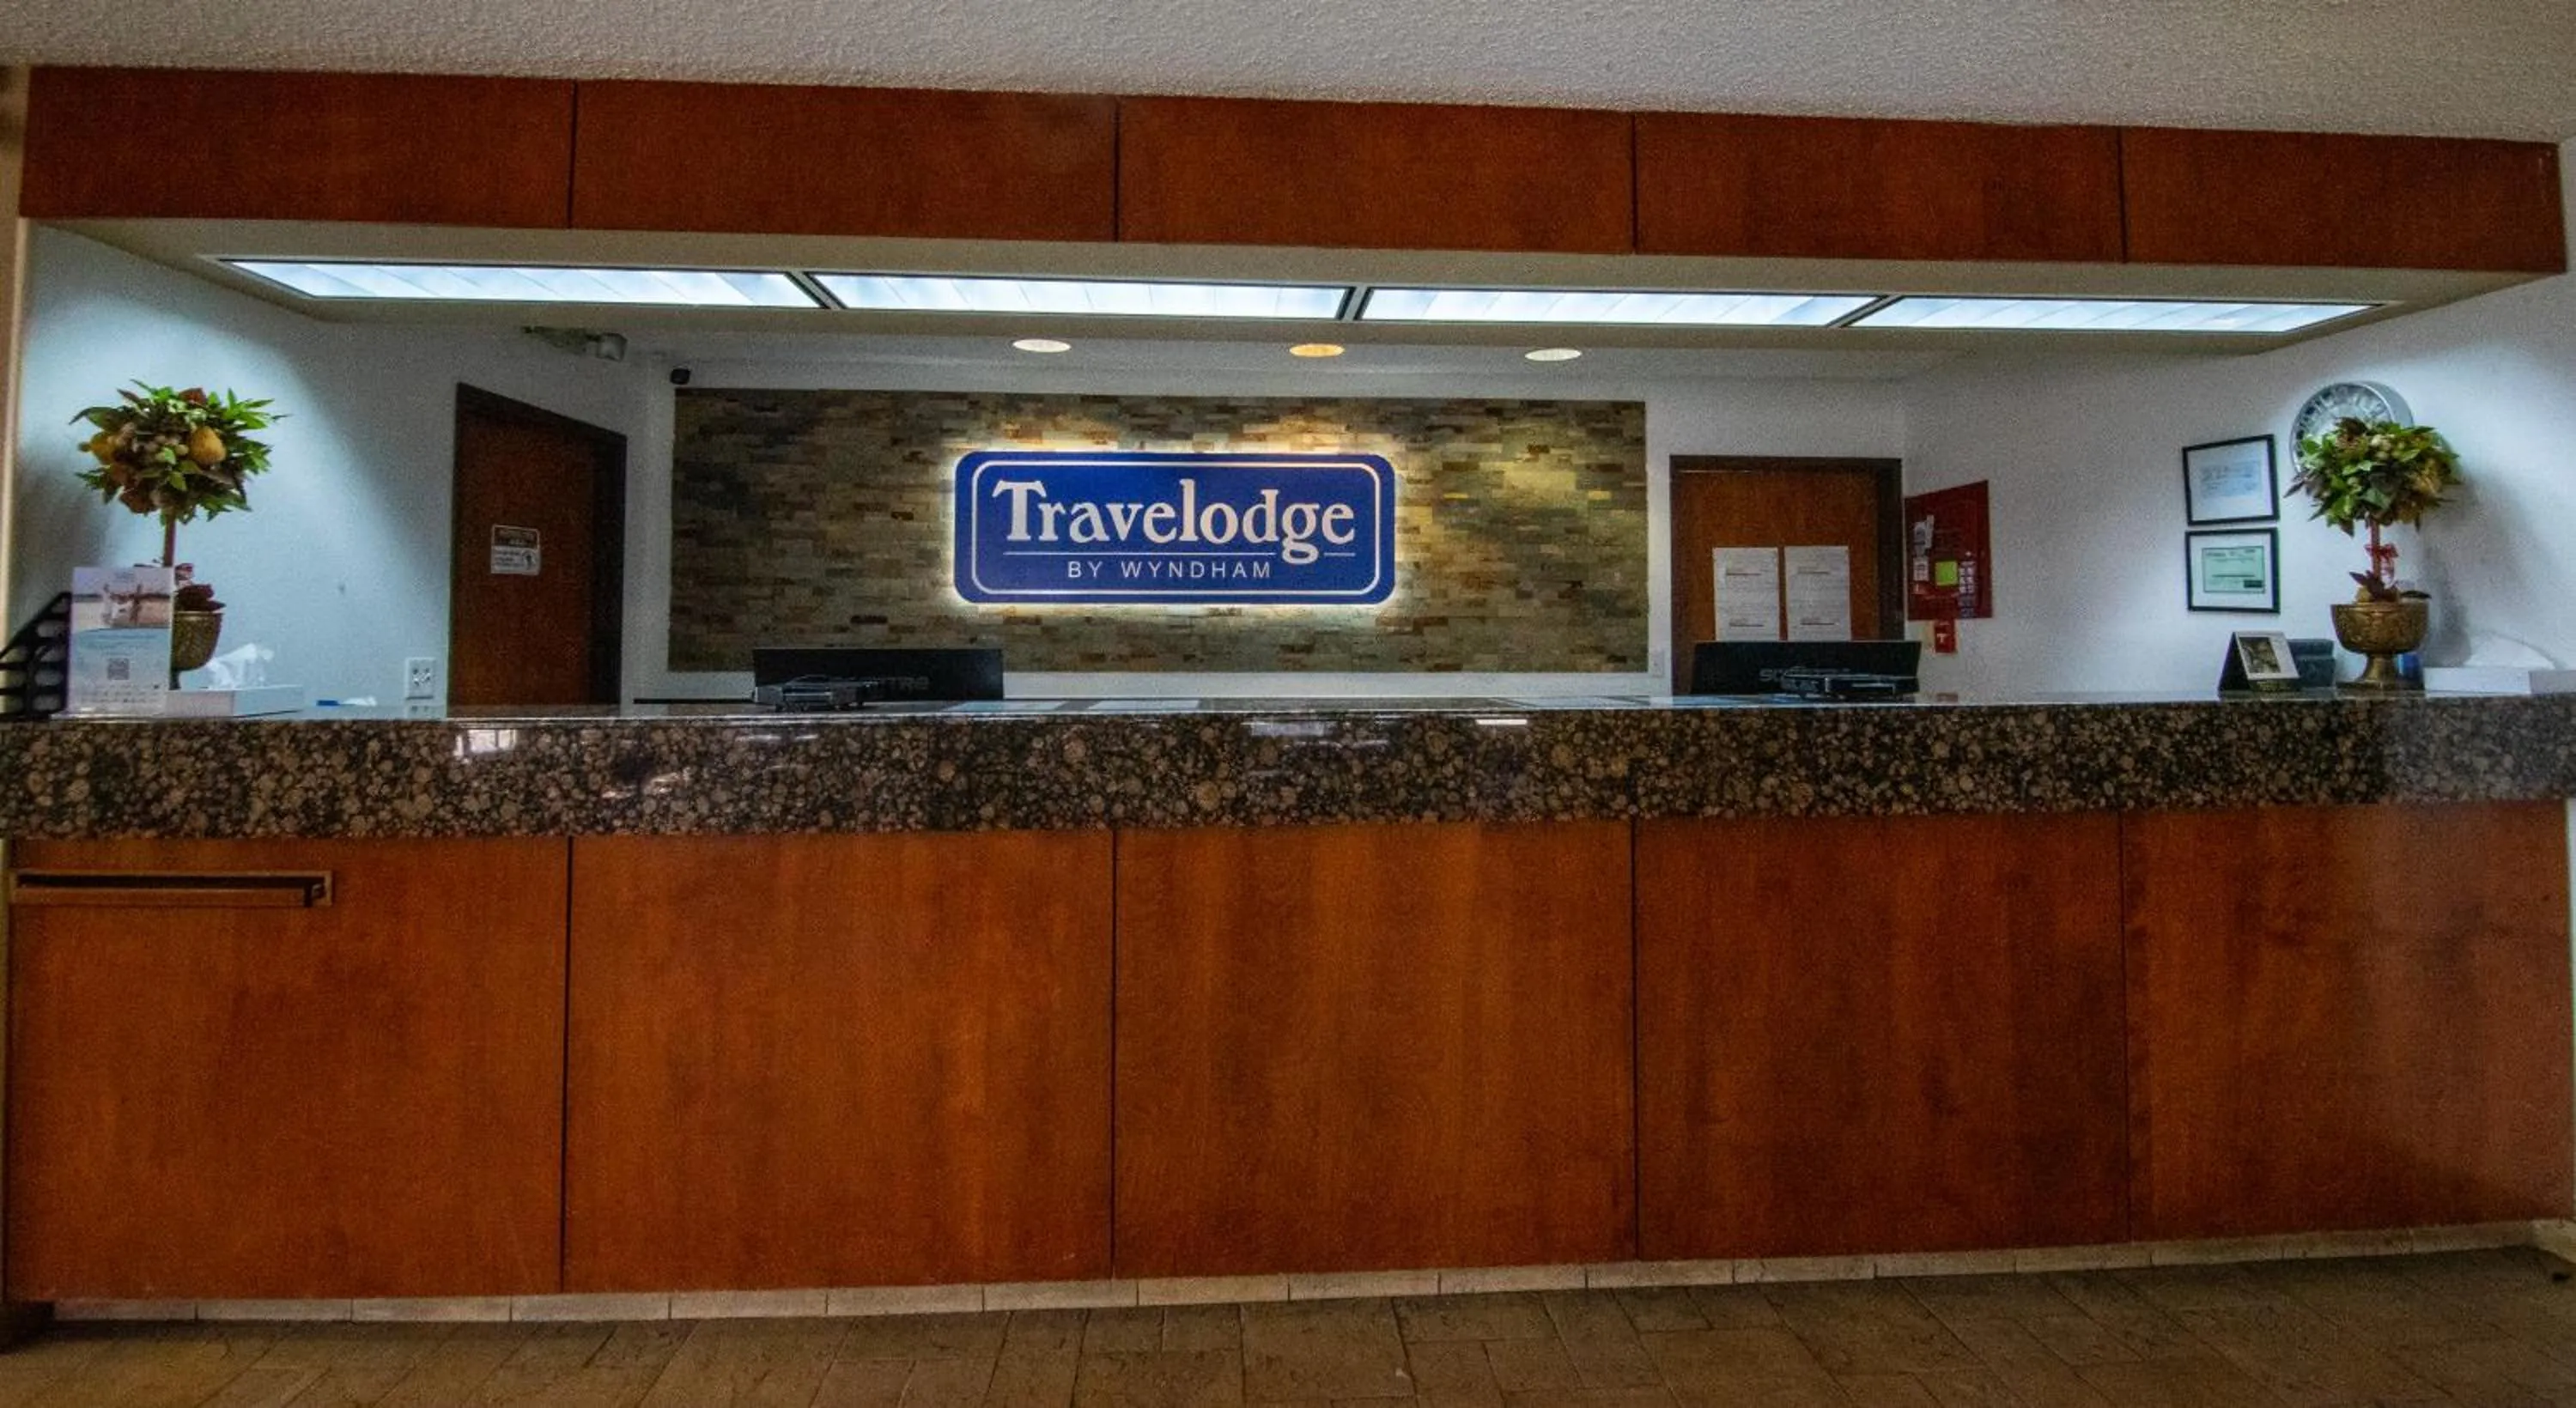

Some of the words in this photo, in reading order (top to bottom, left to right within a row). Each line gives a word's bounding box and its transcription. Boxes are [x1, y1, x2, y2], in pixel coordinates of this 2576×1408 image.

[992, 478, 1355, 564] Travelodge
[1067, 561, 1103, 578] BY
[1121, 561, 1271, 578] WYNDHAM
